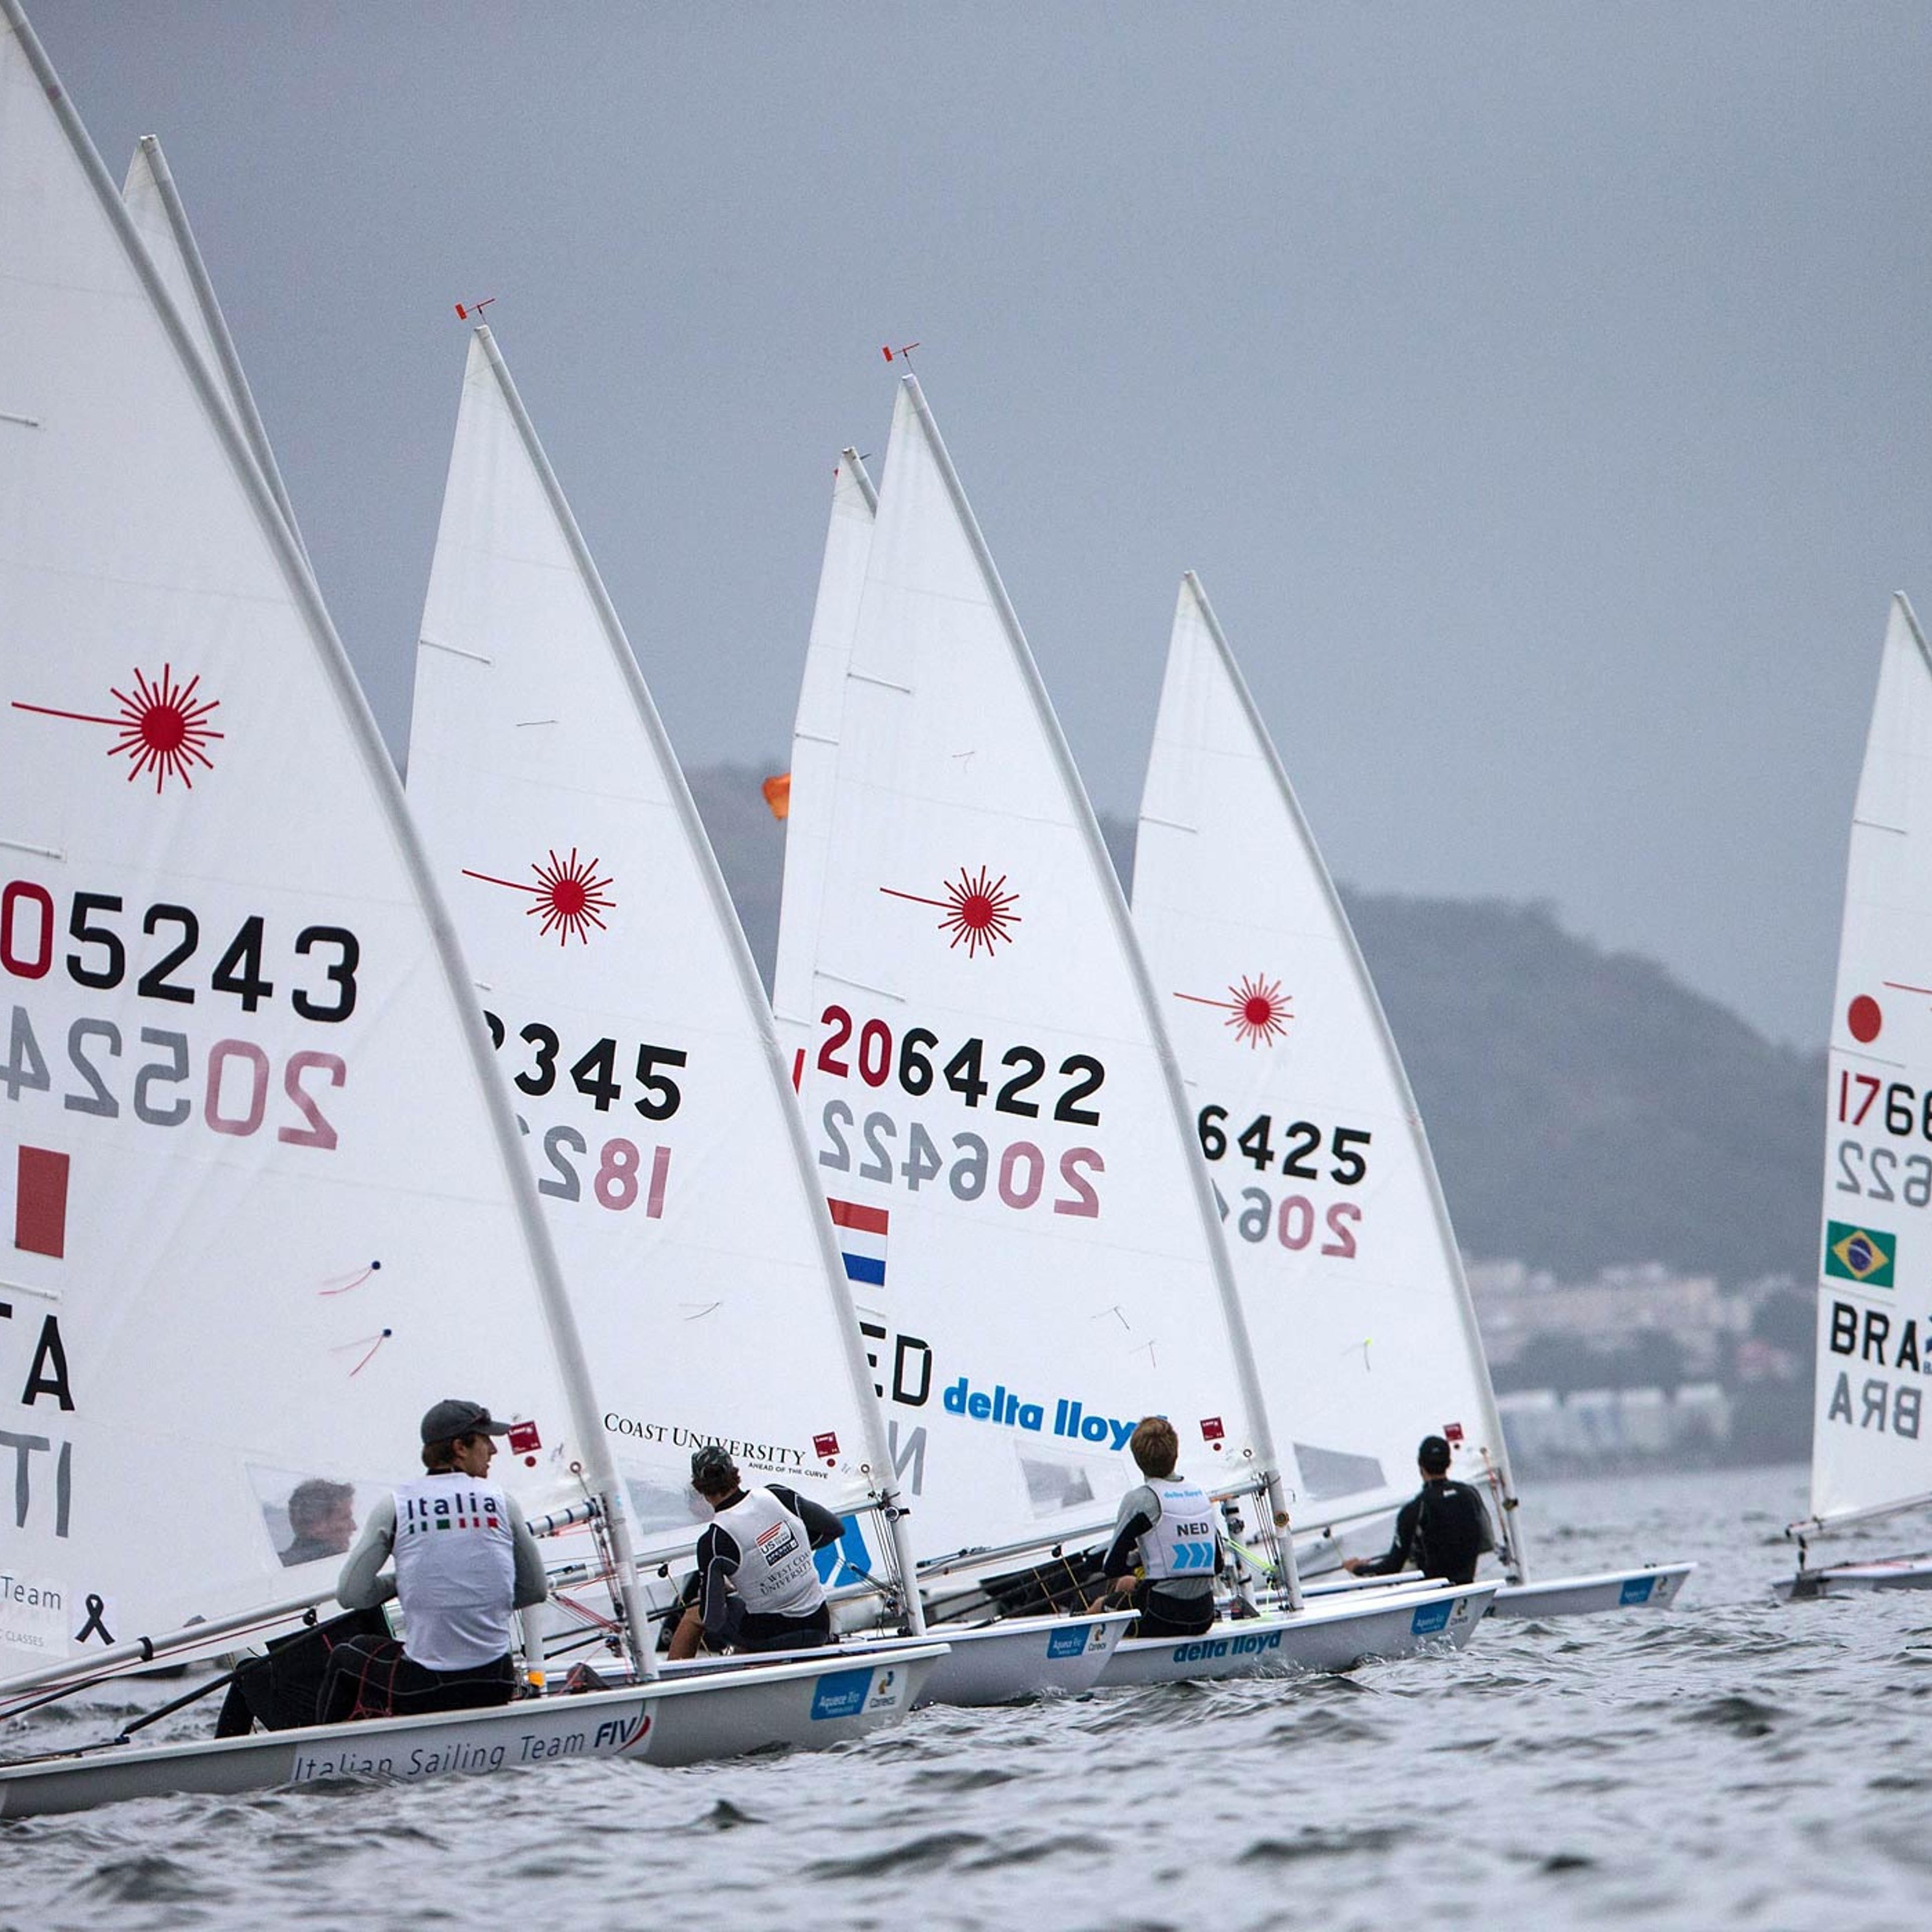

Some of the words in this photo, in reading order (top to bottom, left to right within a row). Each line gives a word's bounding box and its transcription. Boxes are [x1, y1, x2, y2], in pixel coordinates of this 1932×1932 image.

[0, 880, 360, 1023] 05243
[482, 1010, 687, 1121] 345
[817, 1004, 1105, 1127] 206422
[1198, 1104, 1372, 1186] 6425
[1830, 1300, 1920, 1373] BRA
[604, 1412, 668, 1442] COAST
[943, 1377, 1044, 1431] delta
[1054, 1399, 1168, 1451] lloy
[748, 1462, 774, 1472] AHEAD
[804, 1470, 828, 1480] CURVE
[408, 1492, 497, 1520] Italia
[1176, 1522, 1210, 1537] NED
[1, 1575, 61, 1611] Team
[1173, 1641, 1229, 1663] delta
[1231, 1630, 1283, 1656] lloyd
[594, 1716, 637, 1747] FIV
[407, 1744, 505, 1775] Sailing
[521, 1733, 585, 1760] Team
